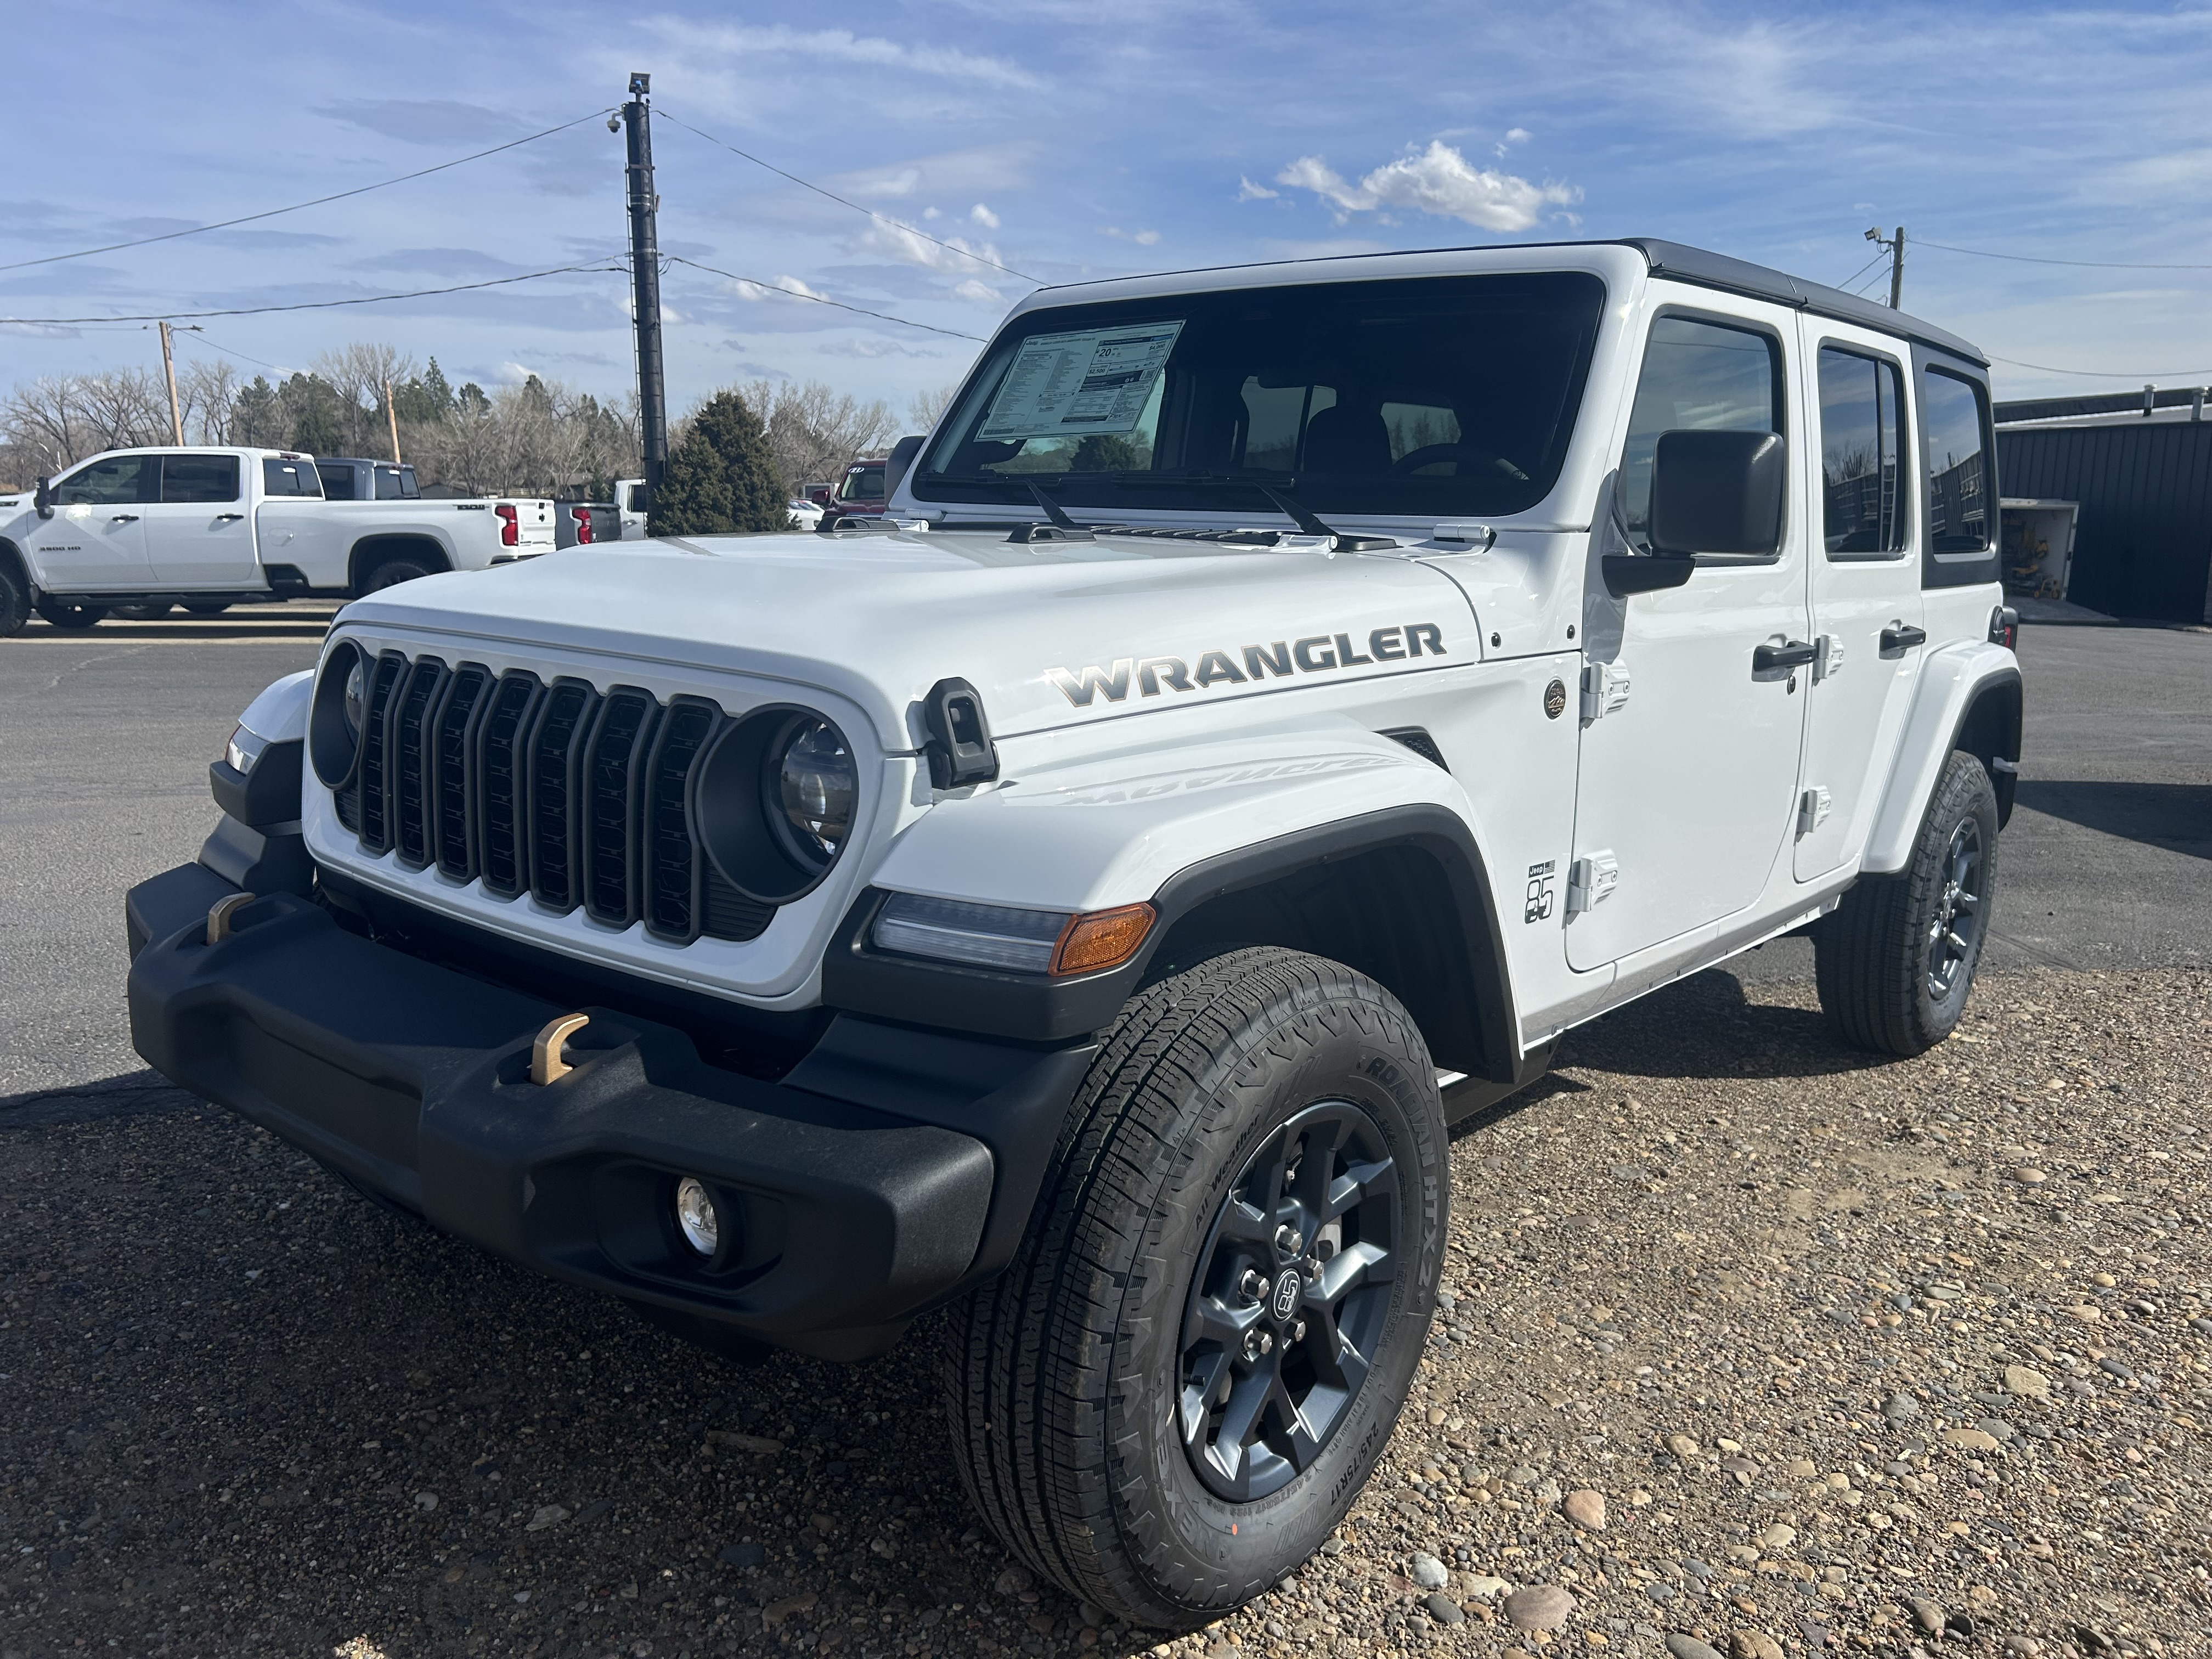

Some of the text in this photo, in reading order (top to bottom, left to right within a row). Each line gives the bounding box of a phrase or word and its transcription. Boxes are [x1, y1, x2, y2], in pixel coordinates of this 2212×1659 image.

[1099, 348, 1111, 357] 20
[1043, 623, 1447, 708] WRANGLER
[1524, 875, 1554, 924] 85
[1530, 866, 1543, 875] Jeep
[1364, 1056, 1435, 1167] ROADIAN
[1278, 1278, 1299, 1312] 85
[1154, 1389, 1214, 1560] NEXEN
[1330, 1420, 1380, 1506] 245/75R17
